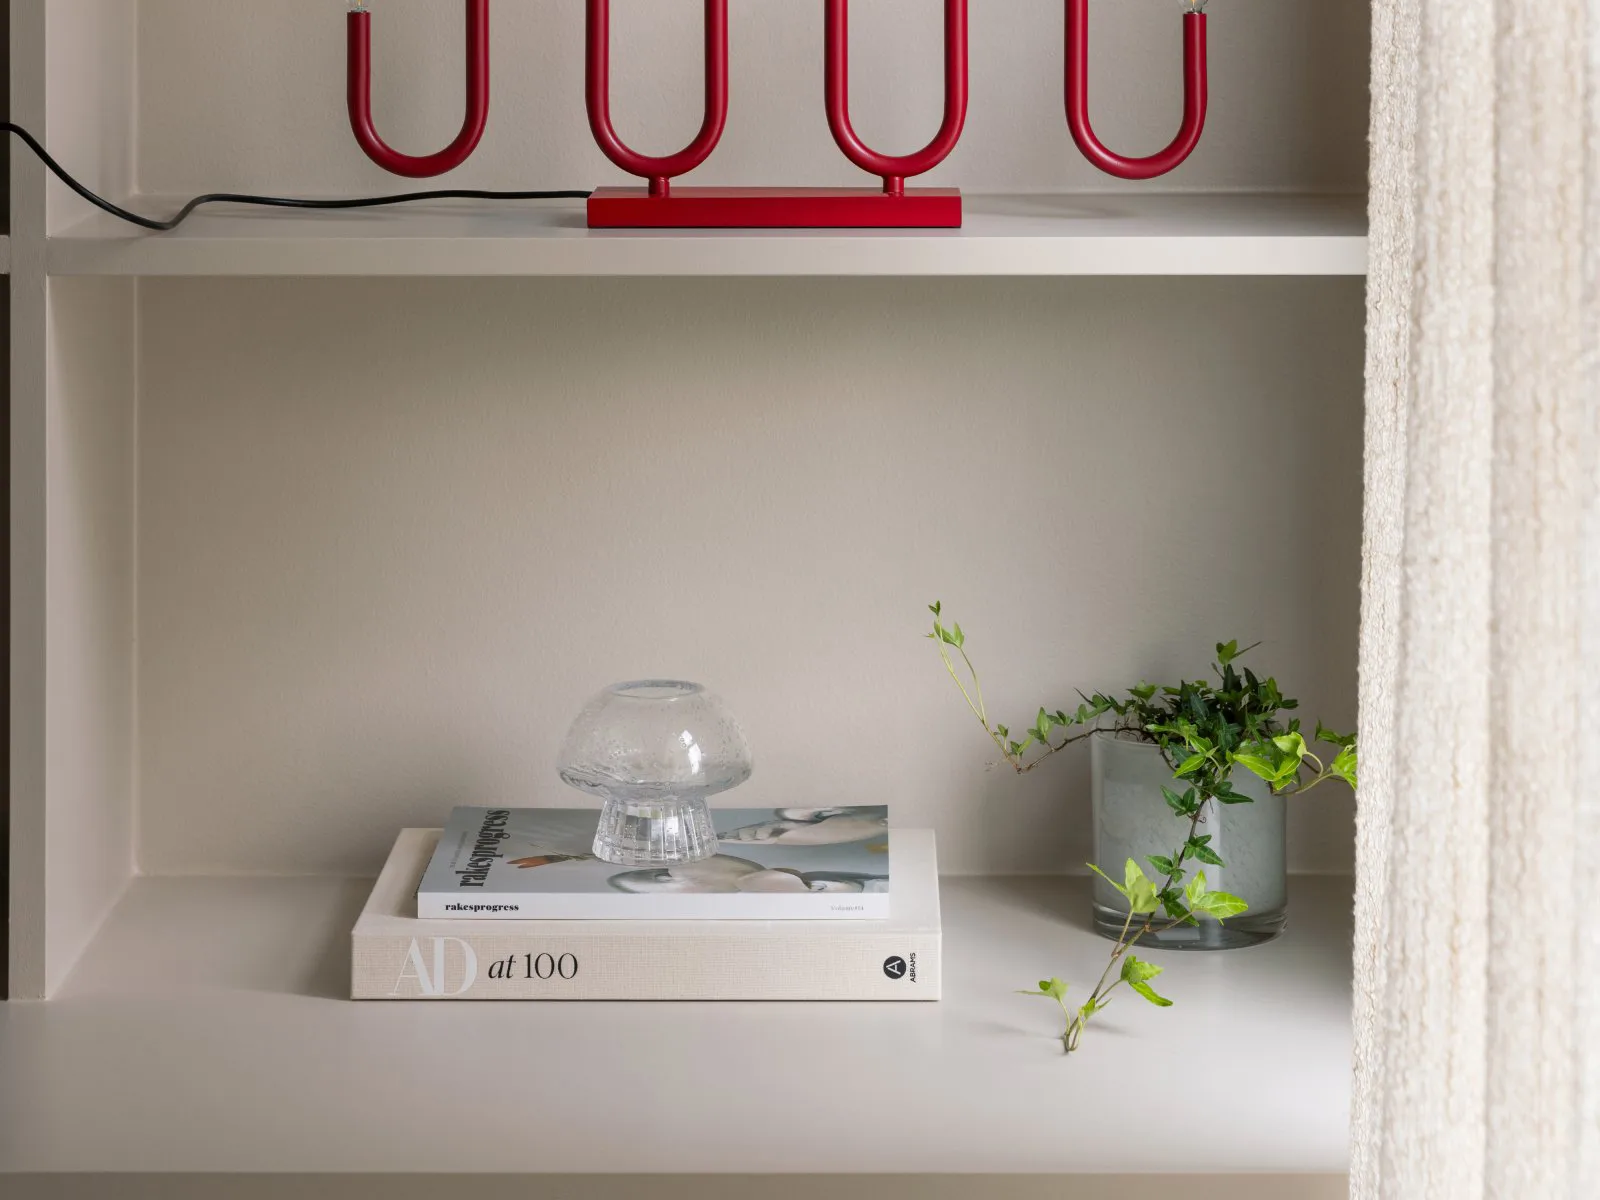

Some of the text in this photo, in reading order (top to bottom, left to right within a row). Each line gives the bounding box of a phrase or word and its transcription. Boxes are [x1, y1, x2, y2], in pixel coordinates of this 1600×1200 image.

[455, 809, 511, 888] rakesprogress
[445, 903, 519, 912] rakesprogress
[387, 936, 579, 997] AD at 100
[909, 952, 917, 984] ABRAMS
